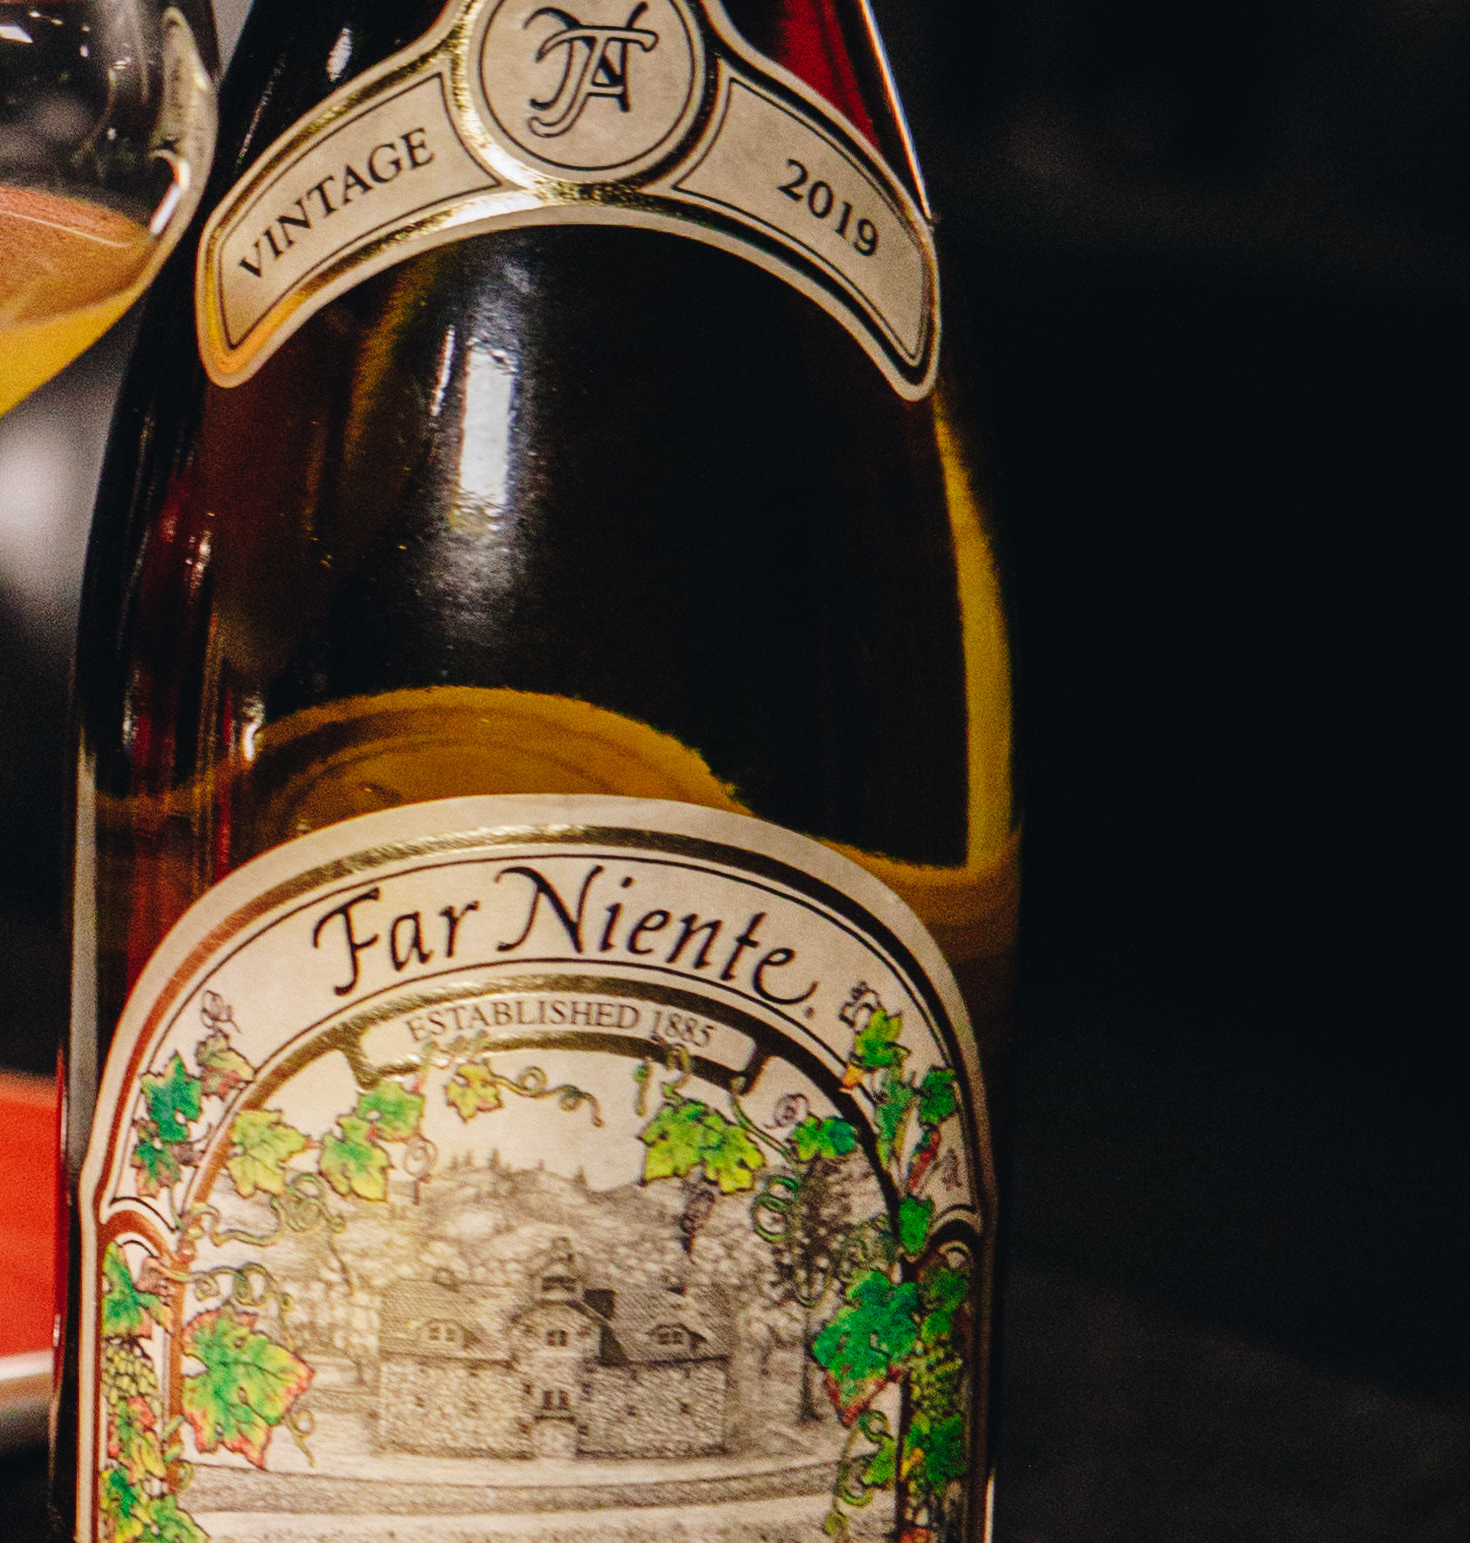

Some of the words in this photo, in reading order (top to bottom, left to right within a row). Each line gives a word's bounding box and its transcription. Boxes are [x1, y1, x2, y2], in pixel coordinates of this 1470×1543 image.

[237, 127, 437, 282] VINTAGE
[776, 158, 880, 257] 2019
[312, 886, 481, 996] Far
[493, 864, 818, 1007] Niente
[405, 999, 640, 1043] ESTABLISHED
[650, 1008, 717, 1048] 1885
